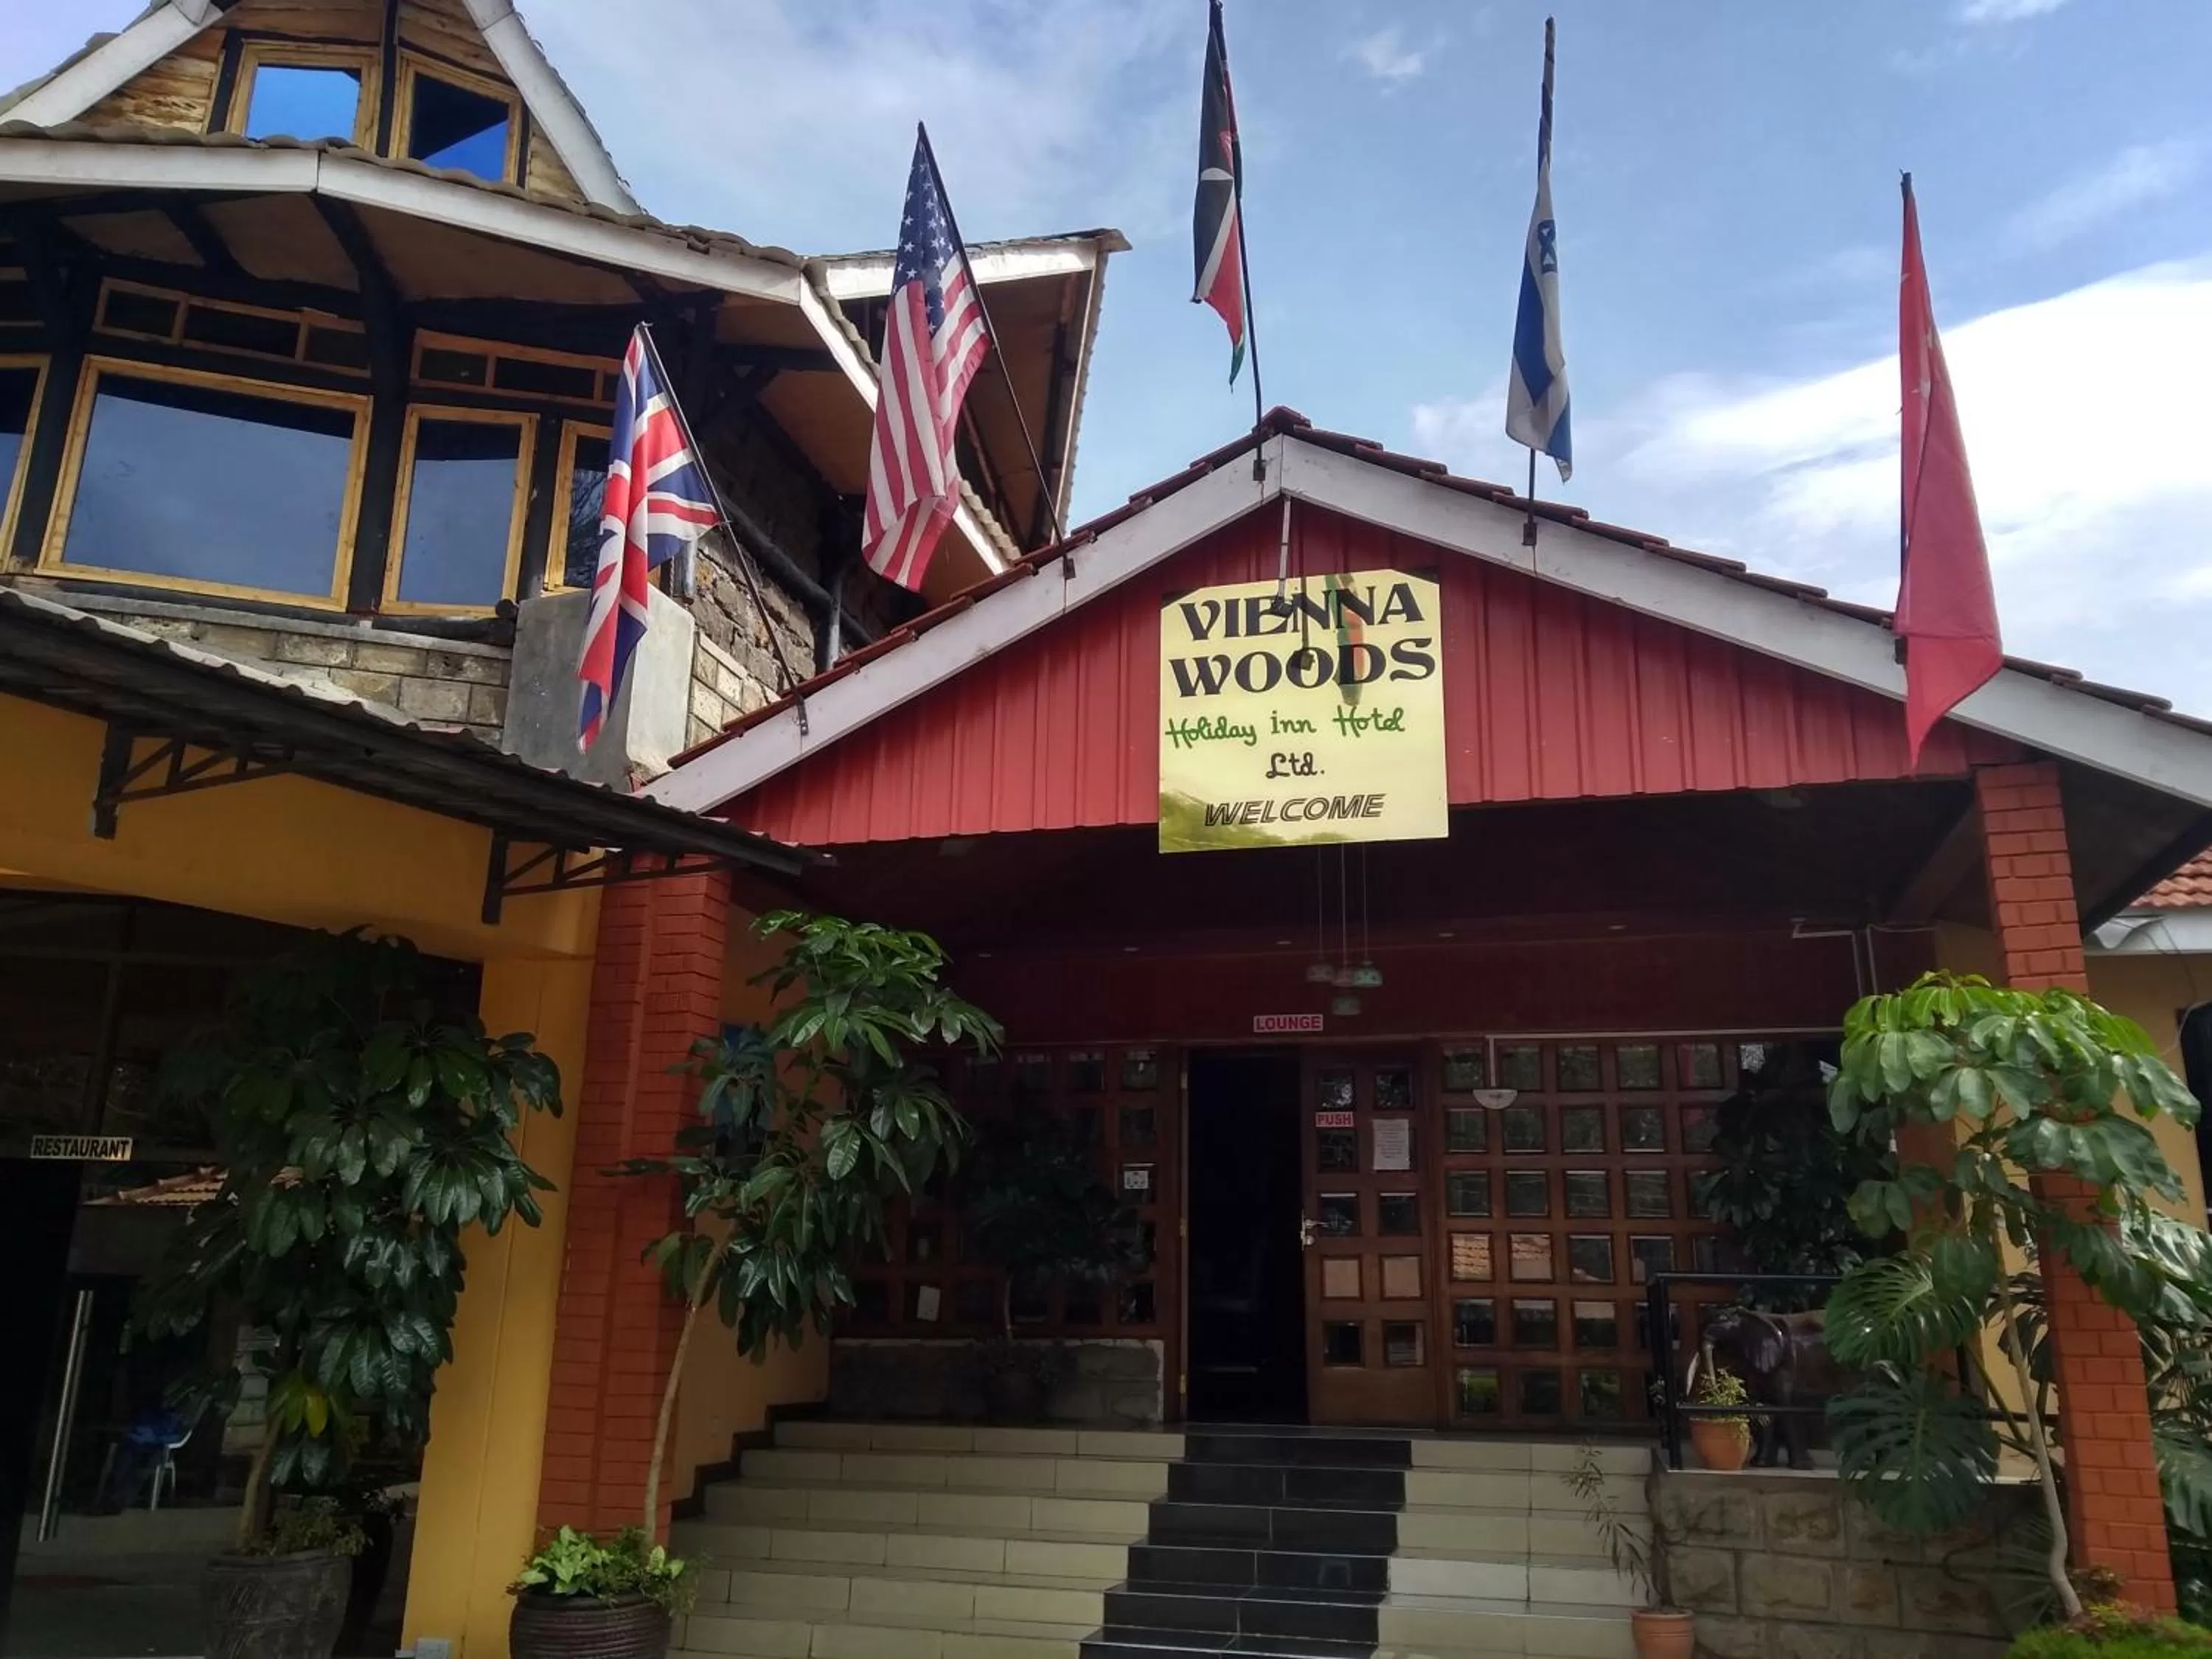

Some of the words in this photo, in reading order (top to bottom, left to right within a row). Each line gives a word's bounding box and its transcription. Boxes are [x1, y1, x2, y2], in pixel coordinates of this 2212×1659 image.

[1180, 582, 1425, 641] VIENNA
[1169, 637, 1436, 698] WOODS
[1165, 716, 1257, 749] Holiday
[1270, 710, 1317, 734] inn
[1332, 705, 1405, 738] Hotel
[1265, 752, 1325, 779] Ltd.
[1204, 793, 1387, 827] WELCOME
[1256, 1016, 1321, 1030] LOUNGE
[1318, 1113, 1352, 1125] PUSH
[33, 1138, 130, 1158] RESTAURANT
